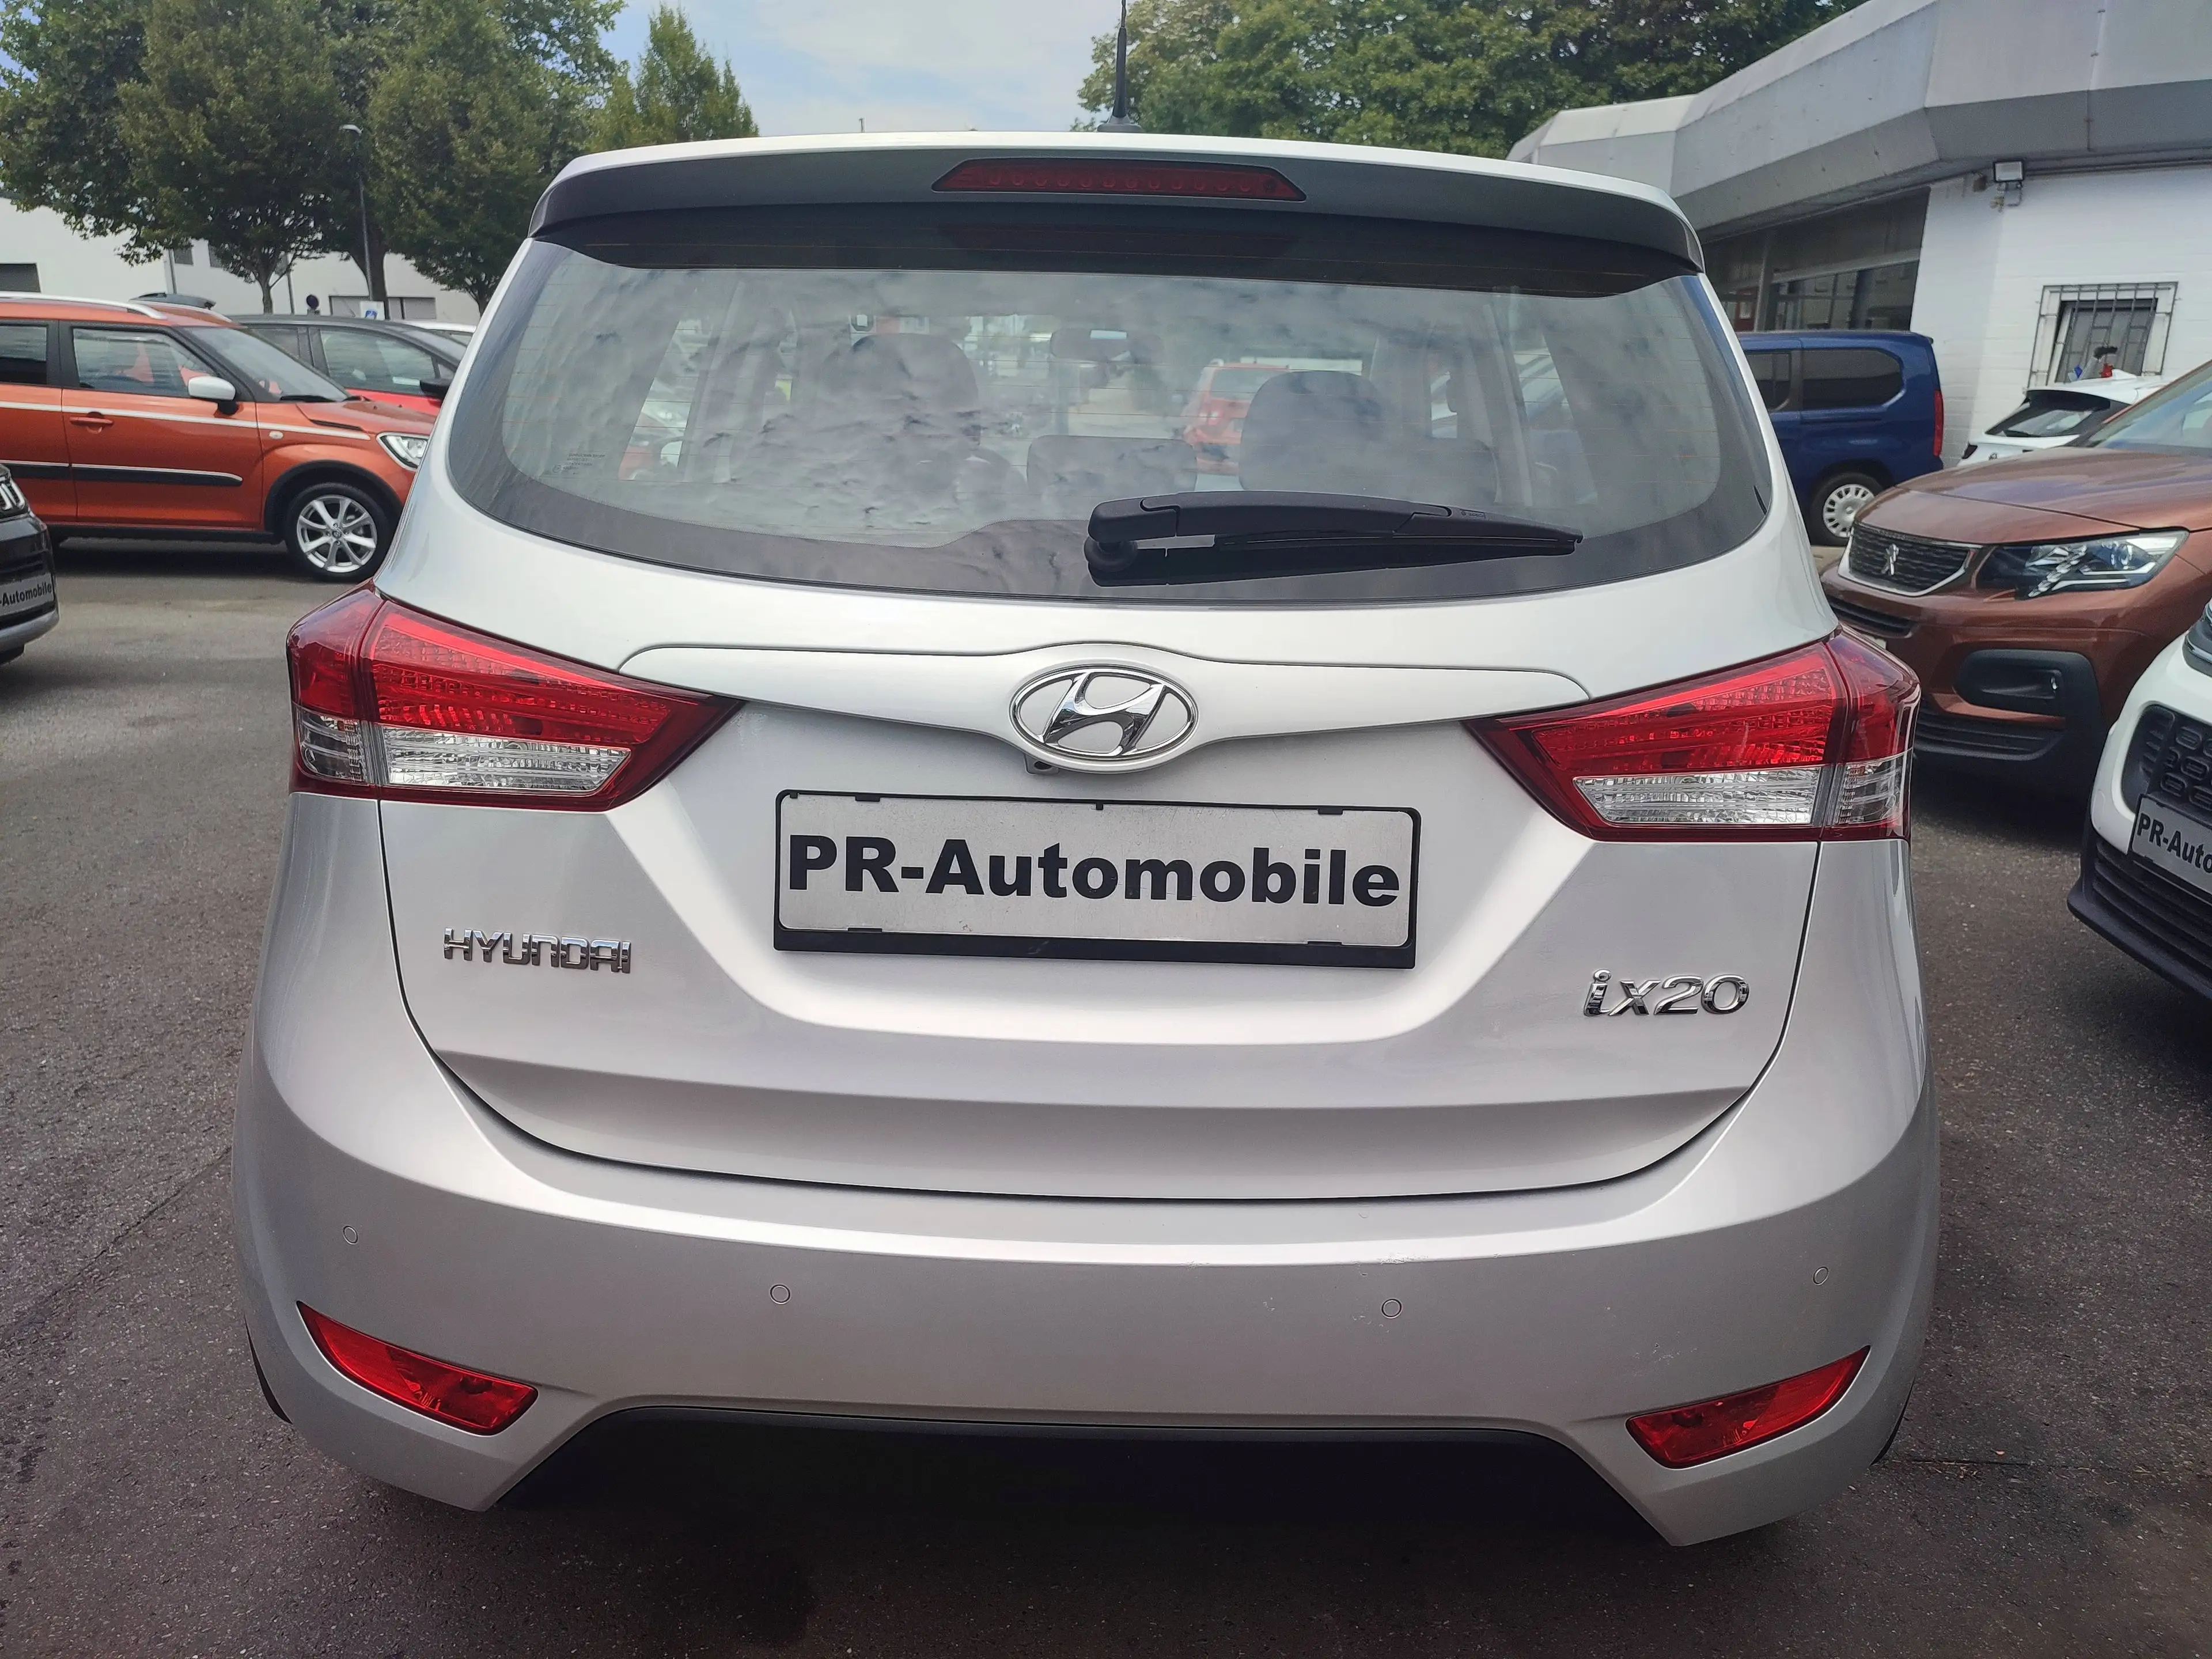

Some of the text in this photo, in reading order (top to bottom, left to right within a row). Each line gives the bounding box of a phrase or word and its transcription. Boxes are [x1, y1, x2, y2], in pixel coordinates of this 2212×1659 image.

[789, 835, 1400, 907] PR-Automobile
[443, 927, 631, 974] HYUNDAI
[1584, 969, 1749, 1016] ix20
